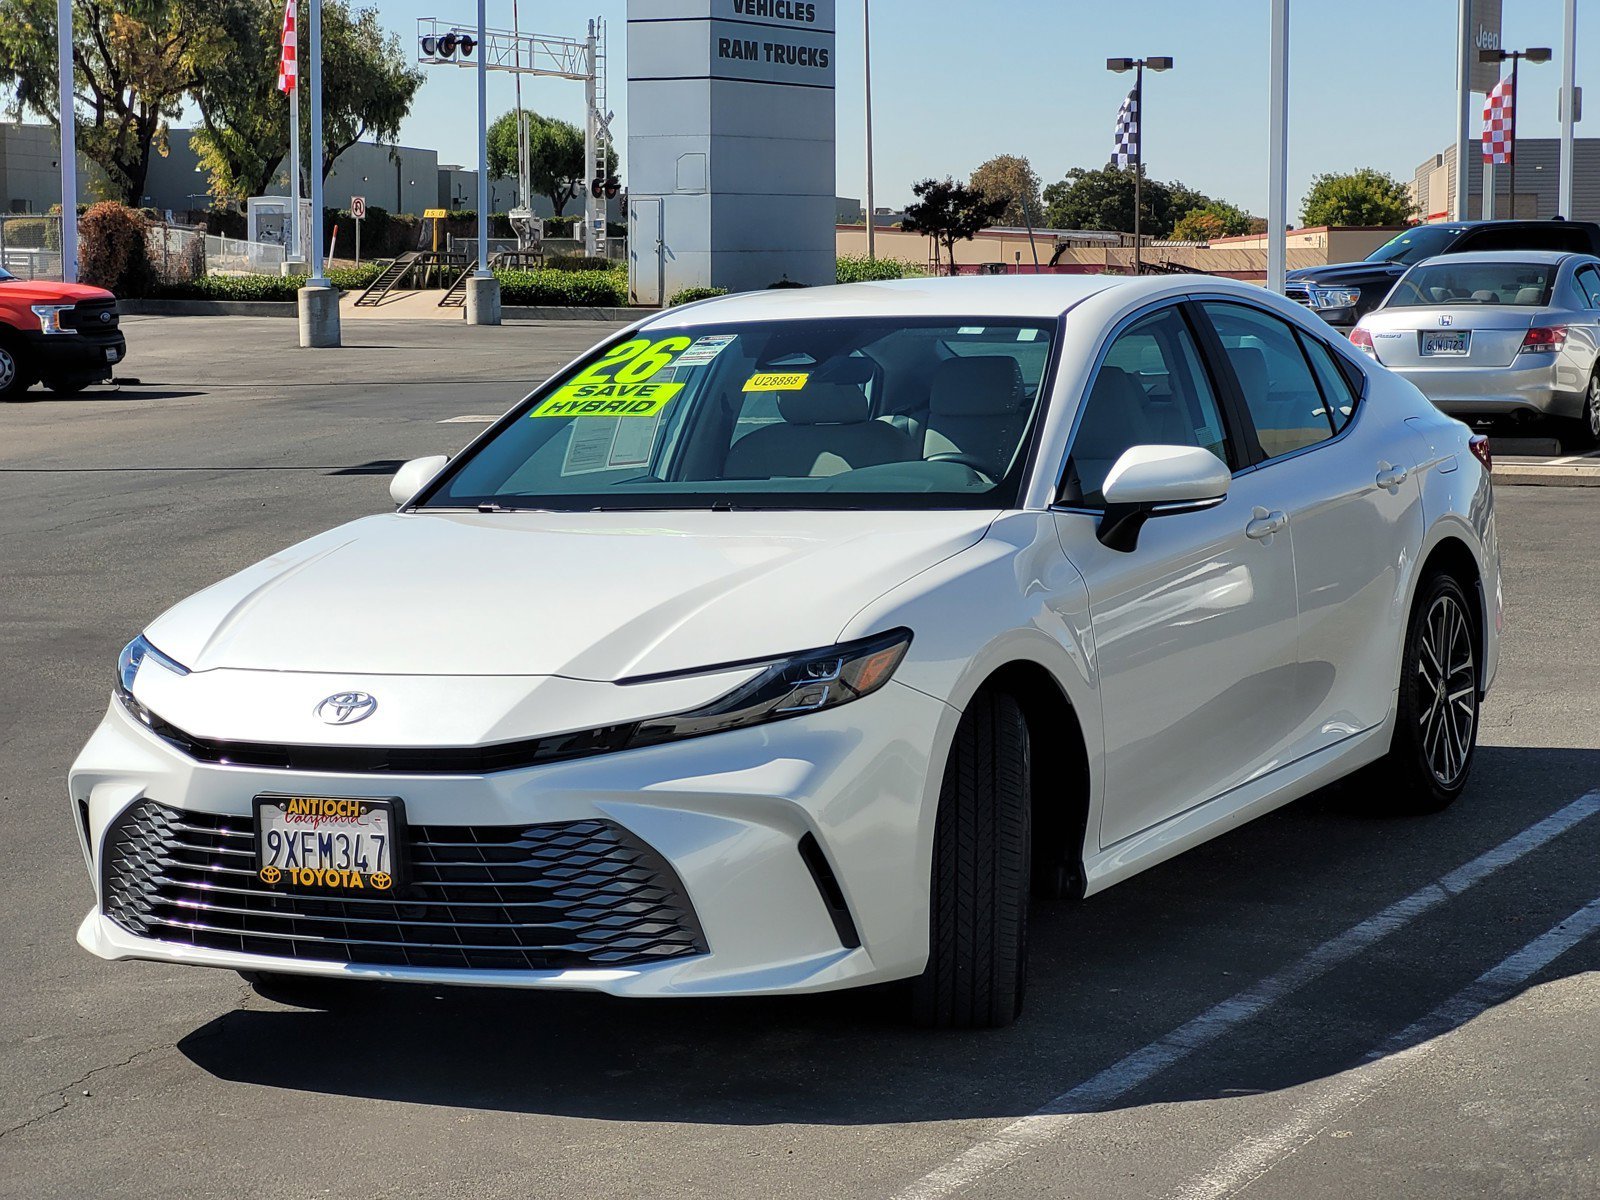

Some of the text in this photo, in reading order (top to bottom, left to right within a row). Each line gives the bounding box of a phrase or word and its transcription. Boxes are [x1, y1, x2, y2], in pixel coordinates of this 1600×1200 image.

[733, 0, 815, 22] VEHICLES
[1475, 23, 1499, 50] Jeep
[718, 37, 829, 68] RAM TRUCKS
[568, 336, 691, 384] 26
[573, 385, 661, 398] SAVE
[754, 376, 800, 387] U28888
[542, 400, 657, 414] HYBRID
[287, 798, 360, 816] ANTIOCH
[267, 829, 385, 872] 9XFM347
[290, 866, 364, 888] TOYOTA
